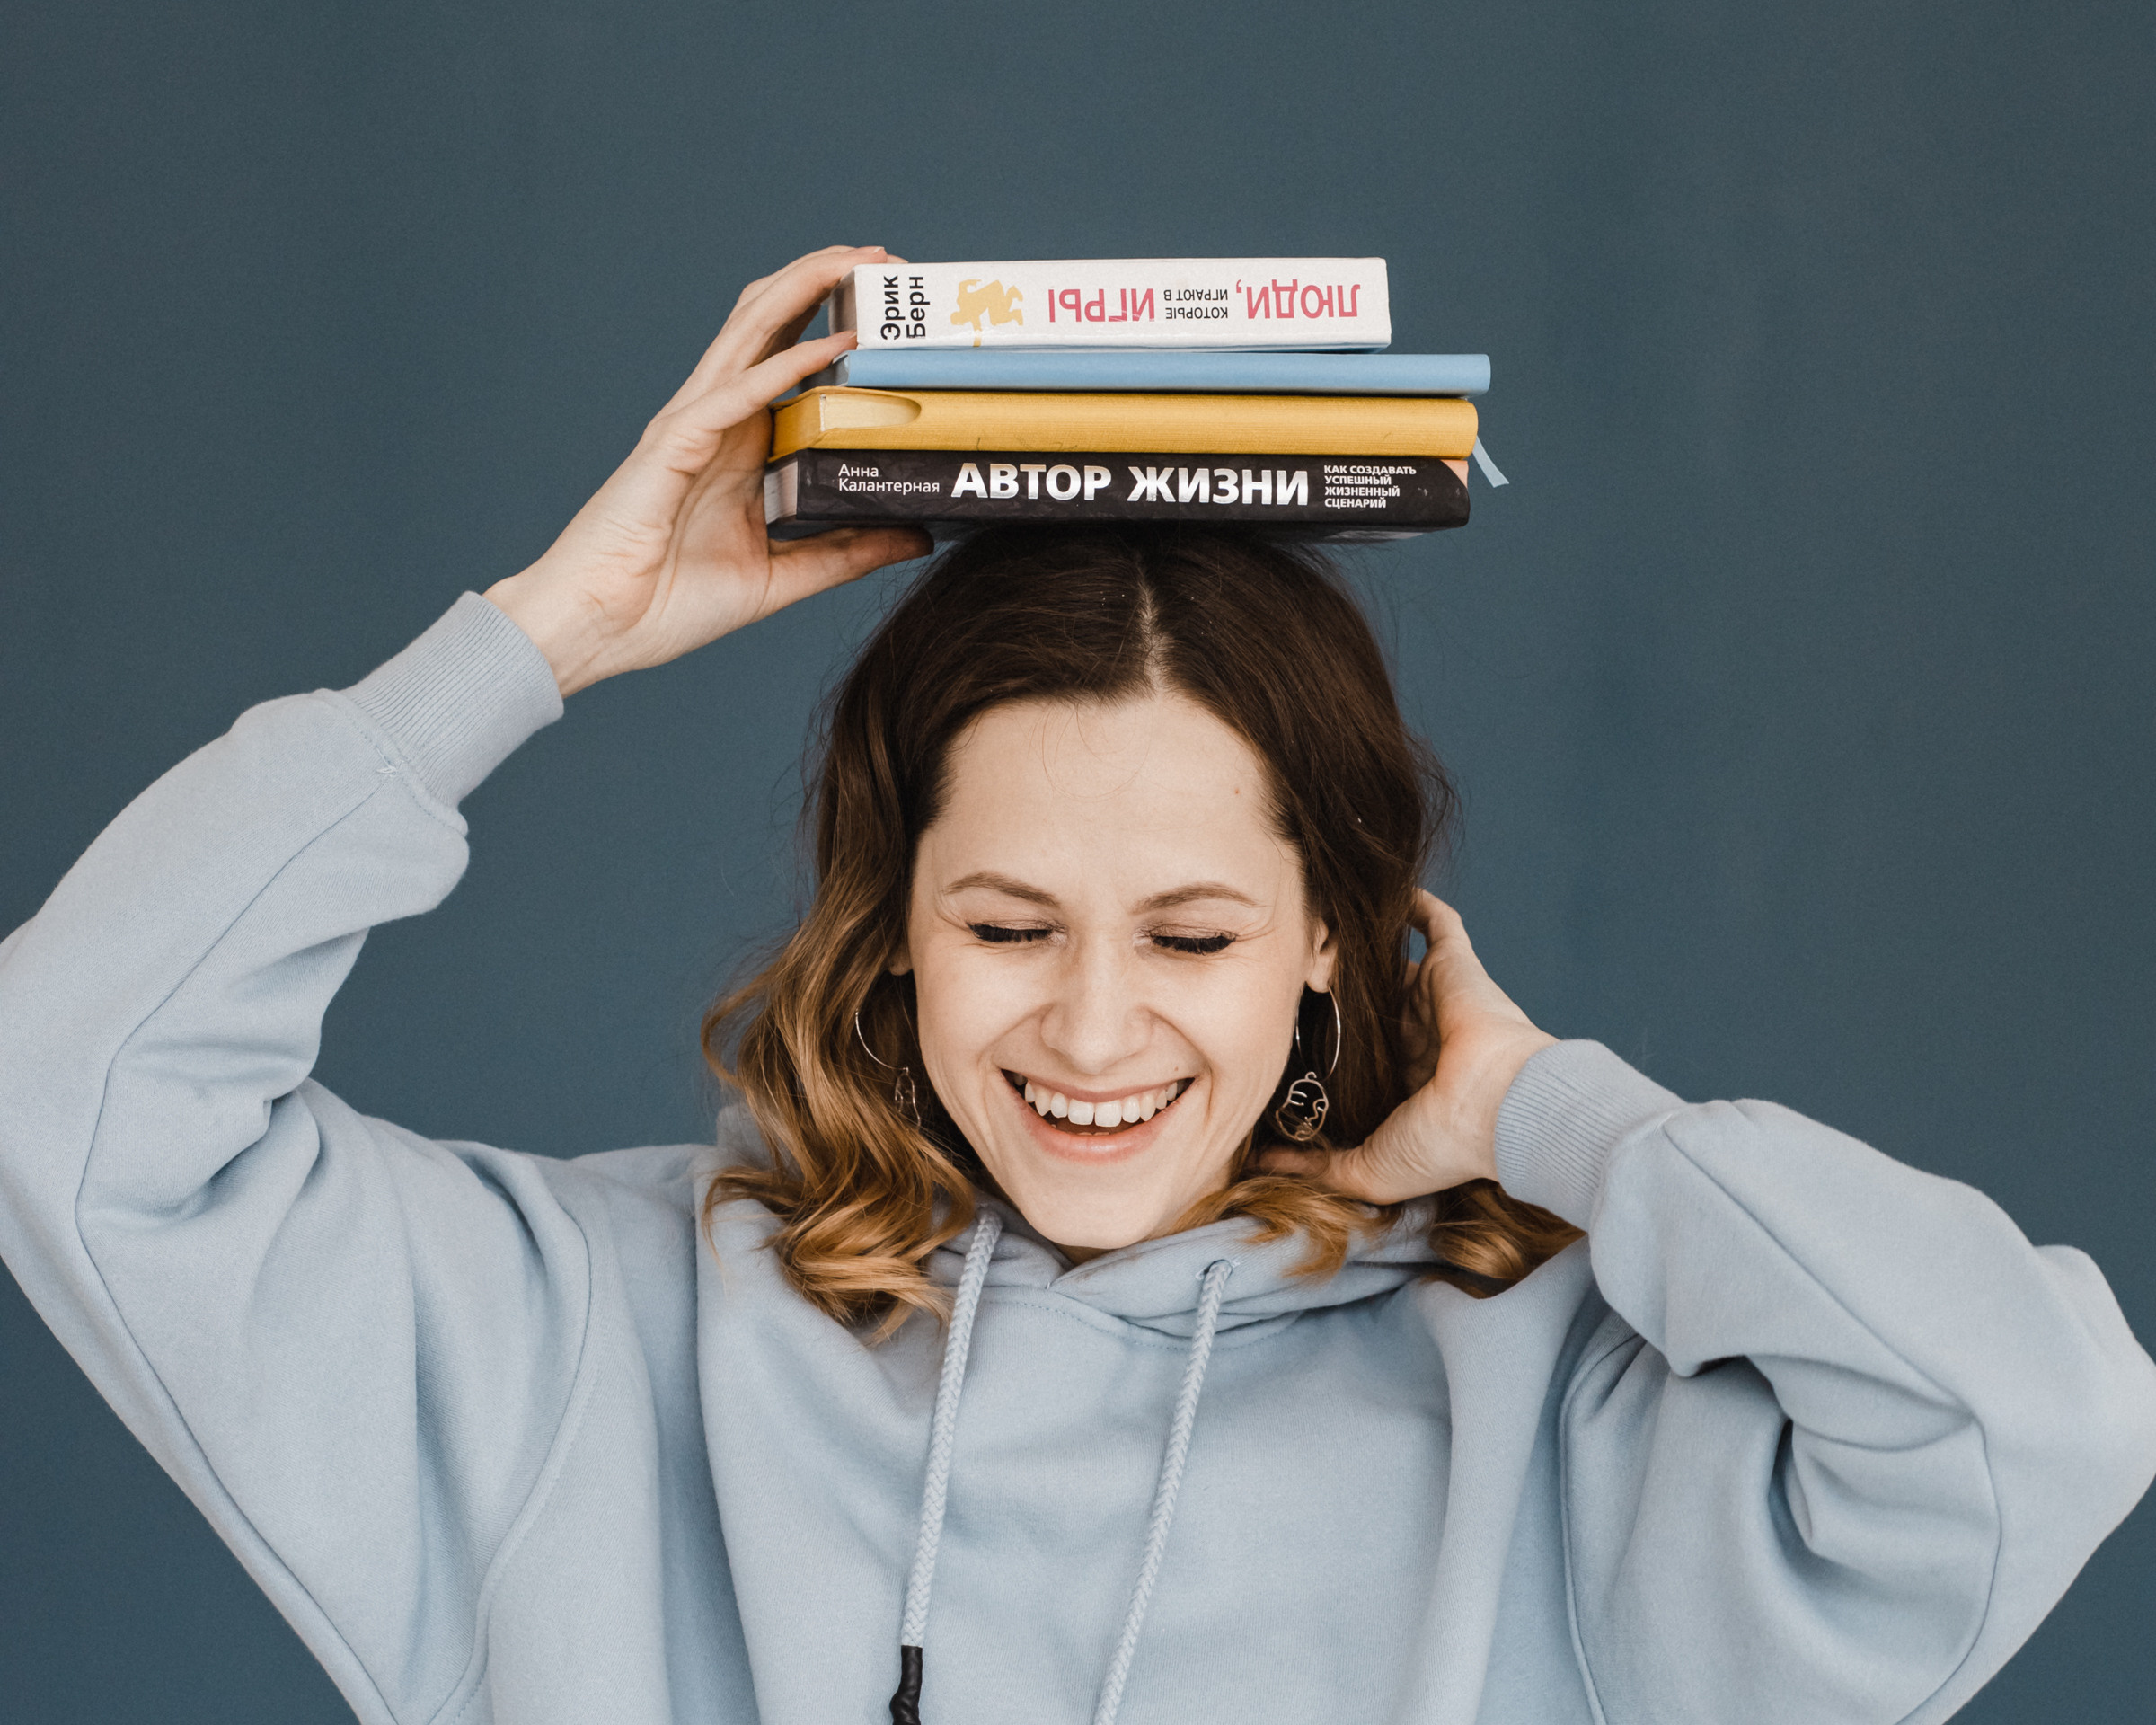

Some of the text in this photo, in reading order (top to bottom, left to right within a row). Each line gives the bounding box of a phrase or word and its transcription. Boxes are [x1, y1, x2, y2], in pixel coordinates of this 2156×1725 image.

[1163, 288, 1228, 301] ИГРАЮТ В
[1235, 279, 1361, 320] ЛЮДИ,
[879, 275, 906, 341] Эрик
[906, 276, 931, 340] Берн
[1047, 288, 1155, 323] ИГРЫ
[1165, 306, 1228, 320] КОТОРЫЕ
[838, 464, 879, 477] Анна
[1323, 464, 1417, 475] КАК СОЗДАВАТЬ
[950, 462, 1309, 506] АВТОР ЖИЗНИ
[1323, 474, 1392, 485] УСПЕШНЫЙ
[838, 478, 941, 496] Калантерная
[1324, 485, 1401, 497] ЖИЗНЕННЫЙ
[1324, 496, 1387, 509] СЦЕНАРИЙ
